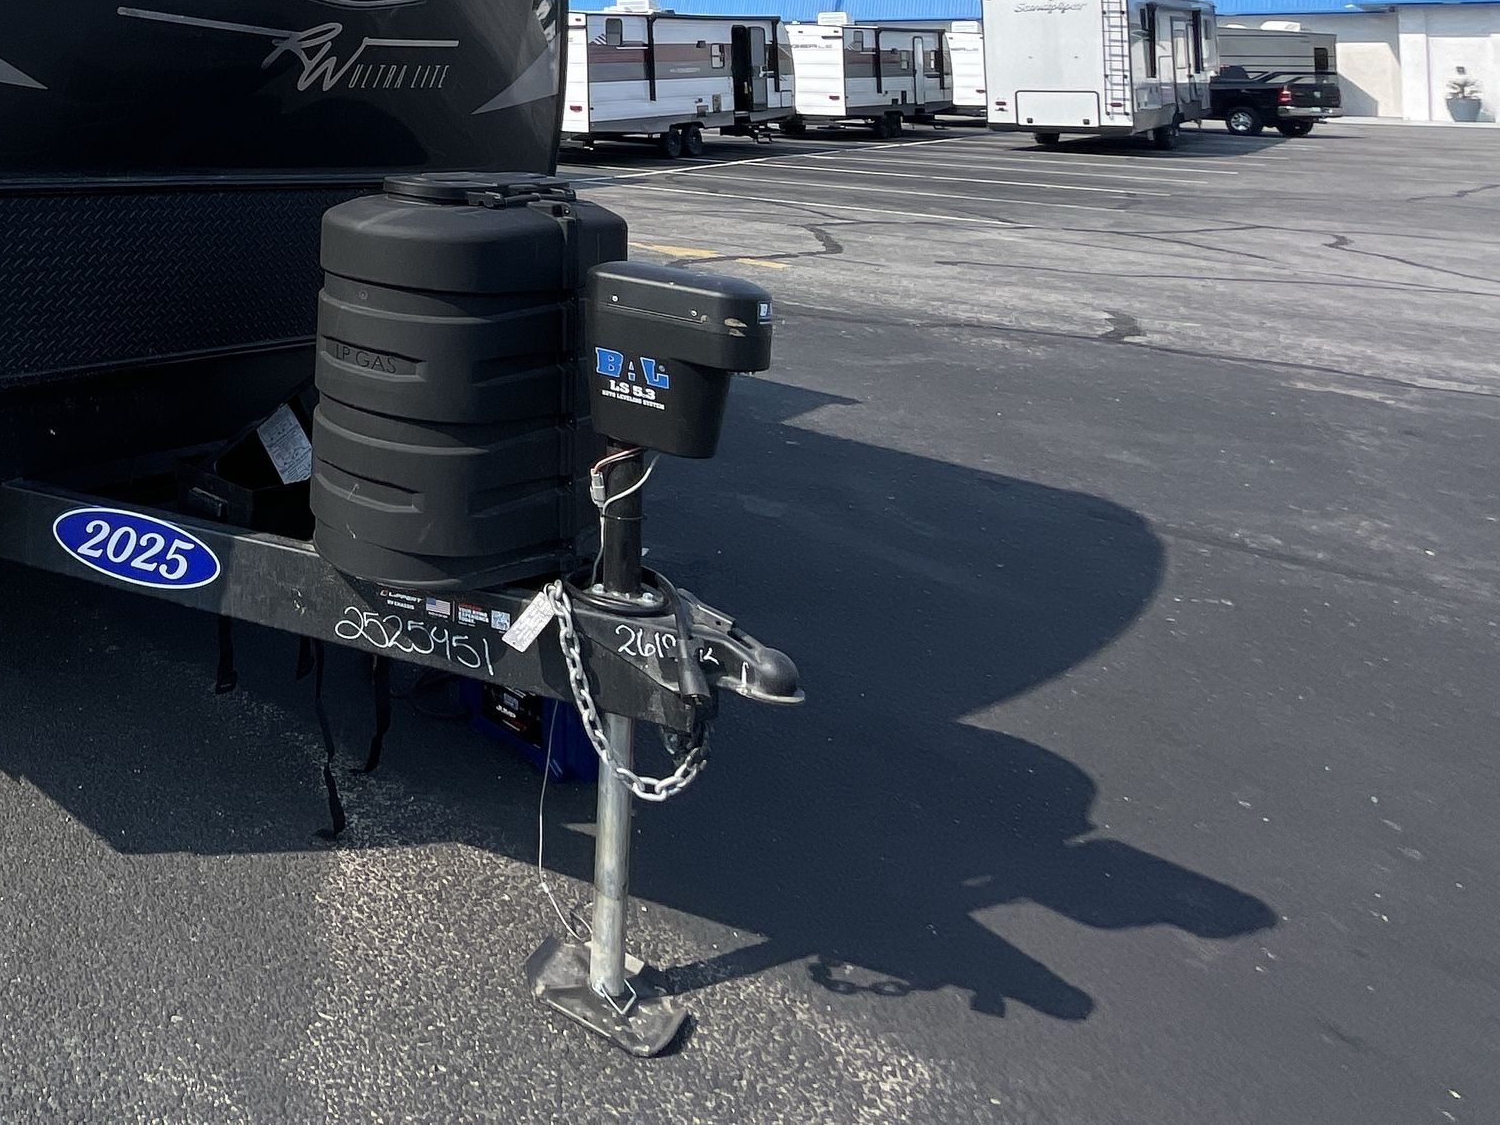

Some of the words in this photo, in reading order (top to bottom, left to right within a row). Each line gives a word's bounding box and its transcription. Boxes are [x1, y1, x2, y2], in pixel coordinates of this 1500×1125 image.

[348, 64, 408, 89] ULTRA
[410, 65, 450, 89] LITE
[335, 343, 351, 362] LP
[356, 350, 397, 374] GAS
[595, 346, 670, 390] BAL
[609, 379, 630, 394] LS
[632, 385, 656, 400] 5.3
[76, 519, 196, 581] 2025
[388, 591, 423, 604] LIPPERT
